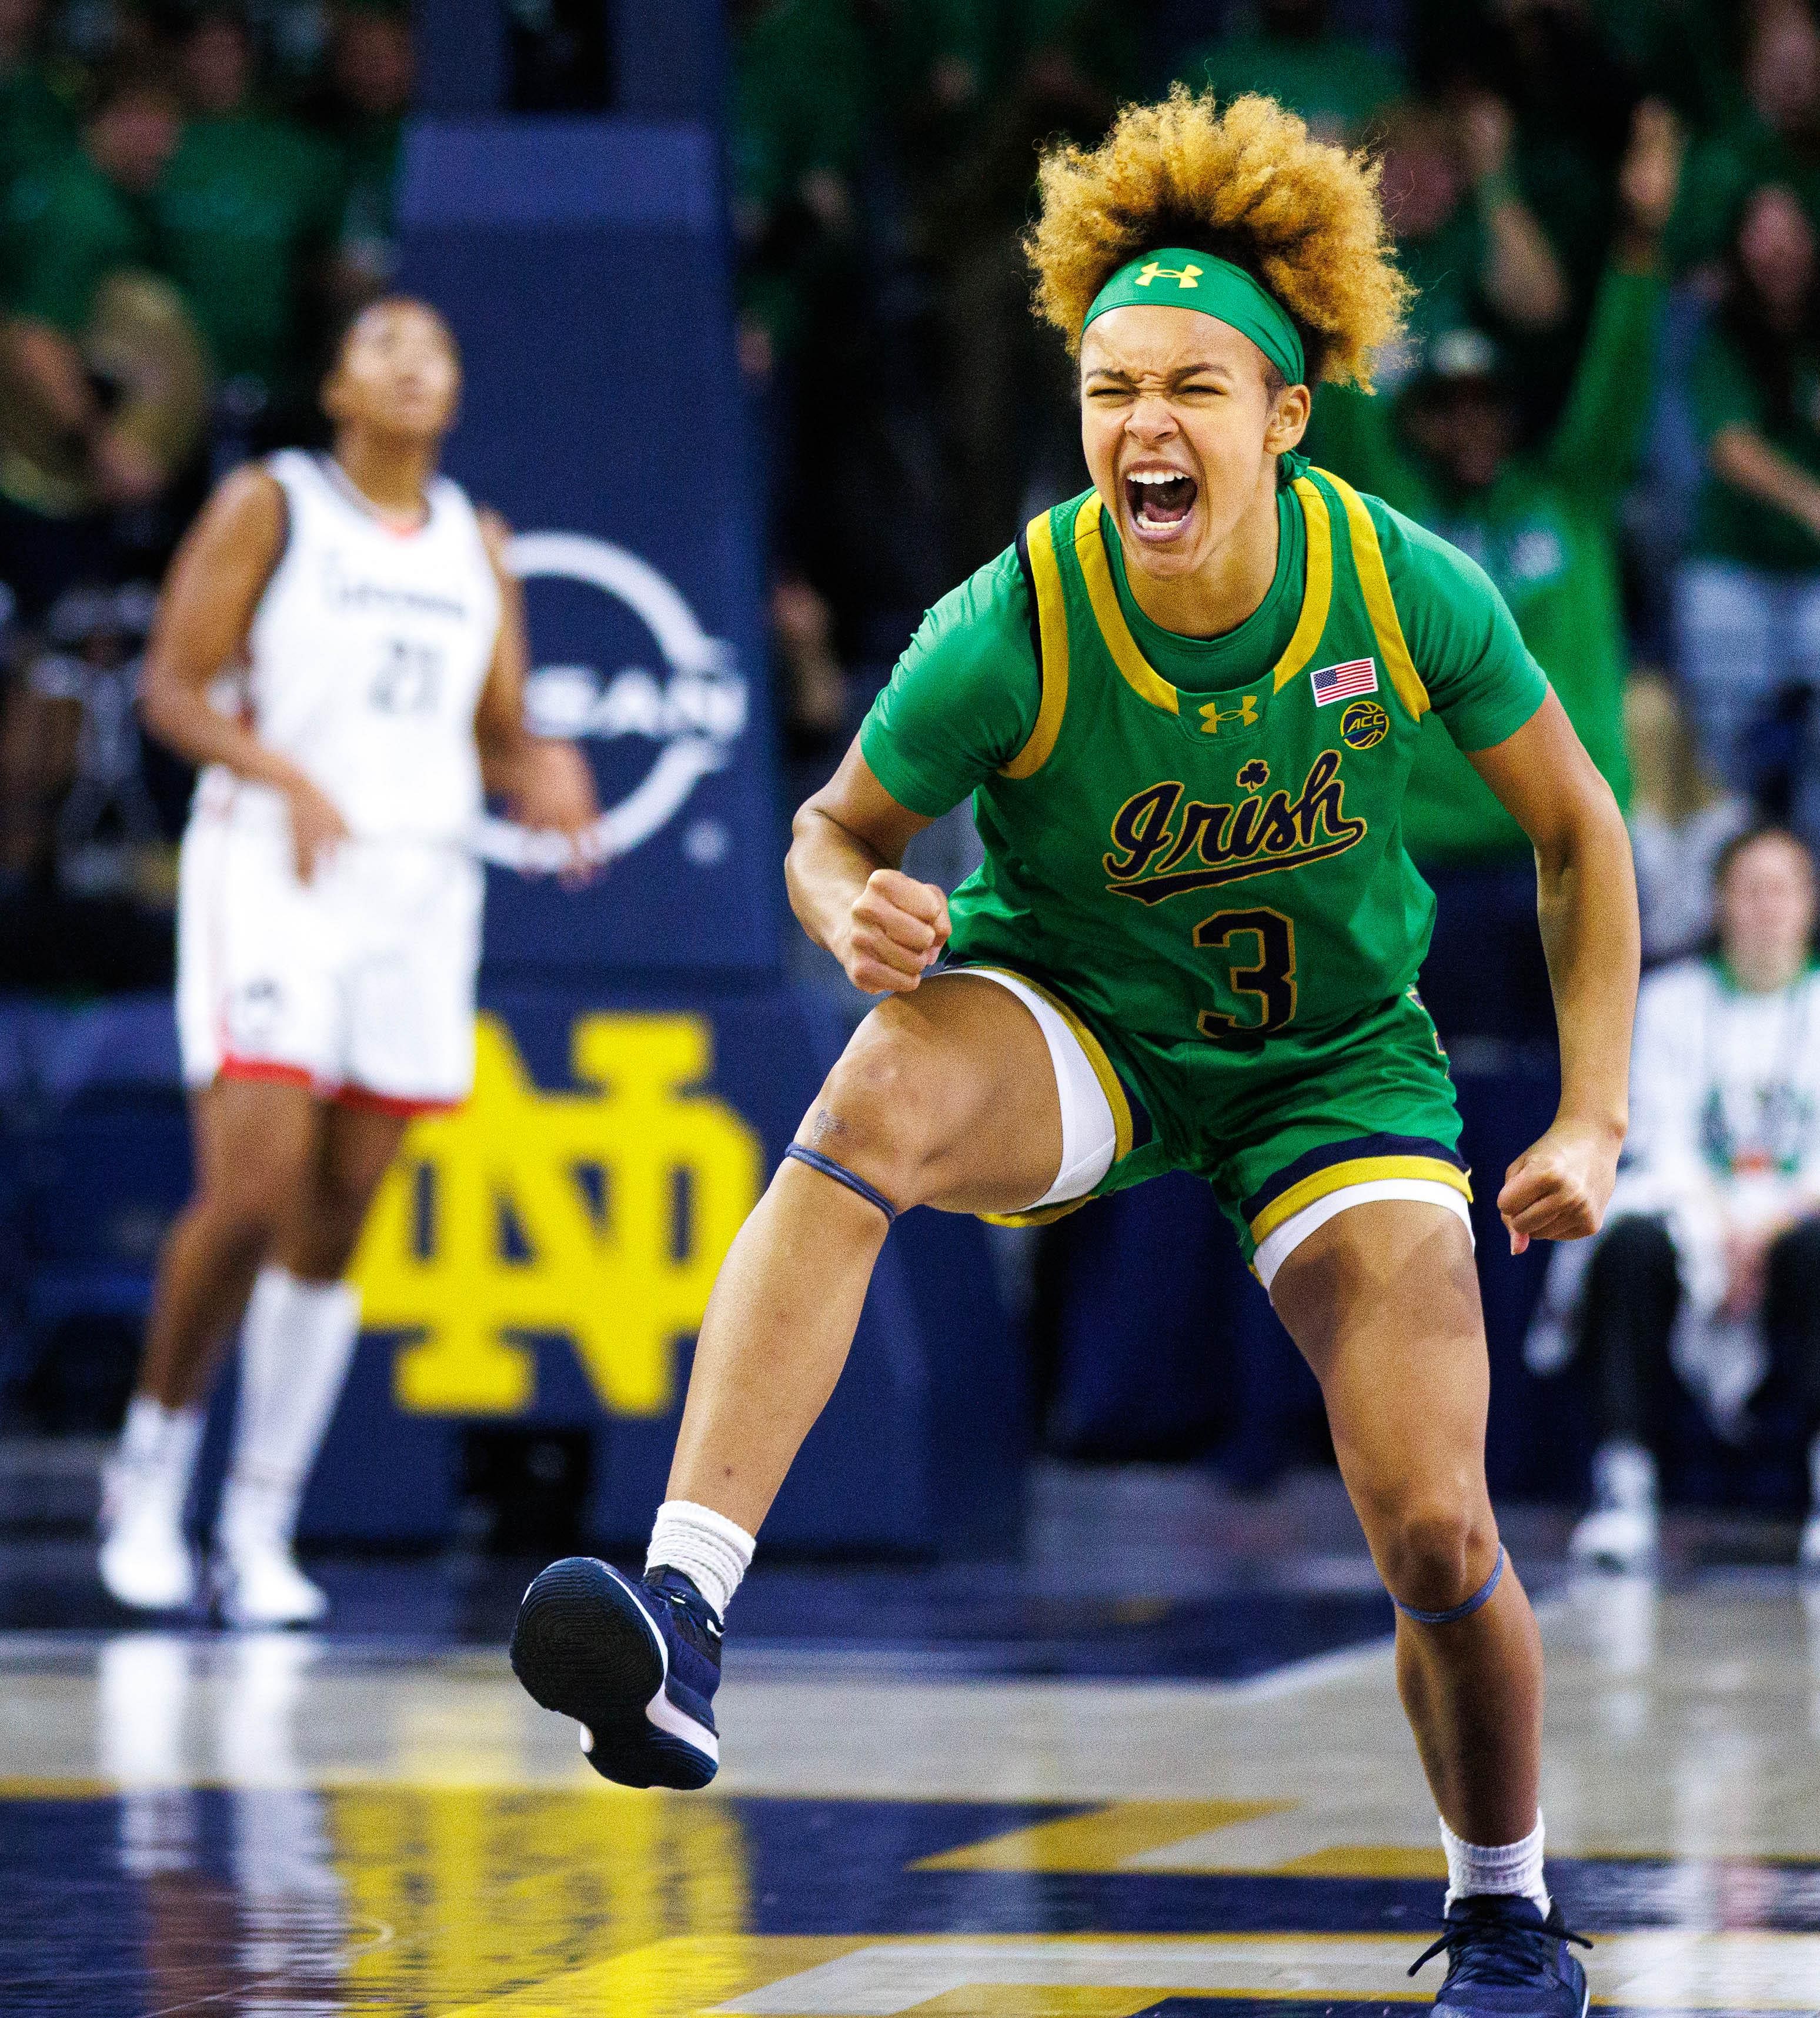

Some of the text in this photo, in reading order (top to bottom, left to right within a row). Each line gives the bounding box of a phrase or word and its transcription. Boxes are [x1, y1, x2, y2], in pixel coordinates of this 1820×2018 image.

[1347, 712, 1385, 733] ACC
[1103, 749, 1367, 906] Irish
[1192, 906, 1297, 1038] 3
